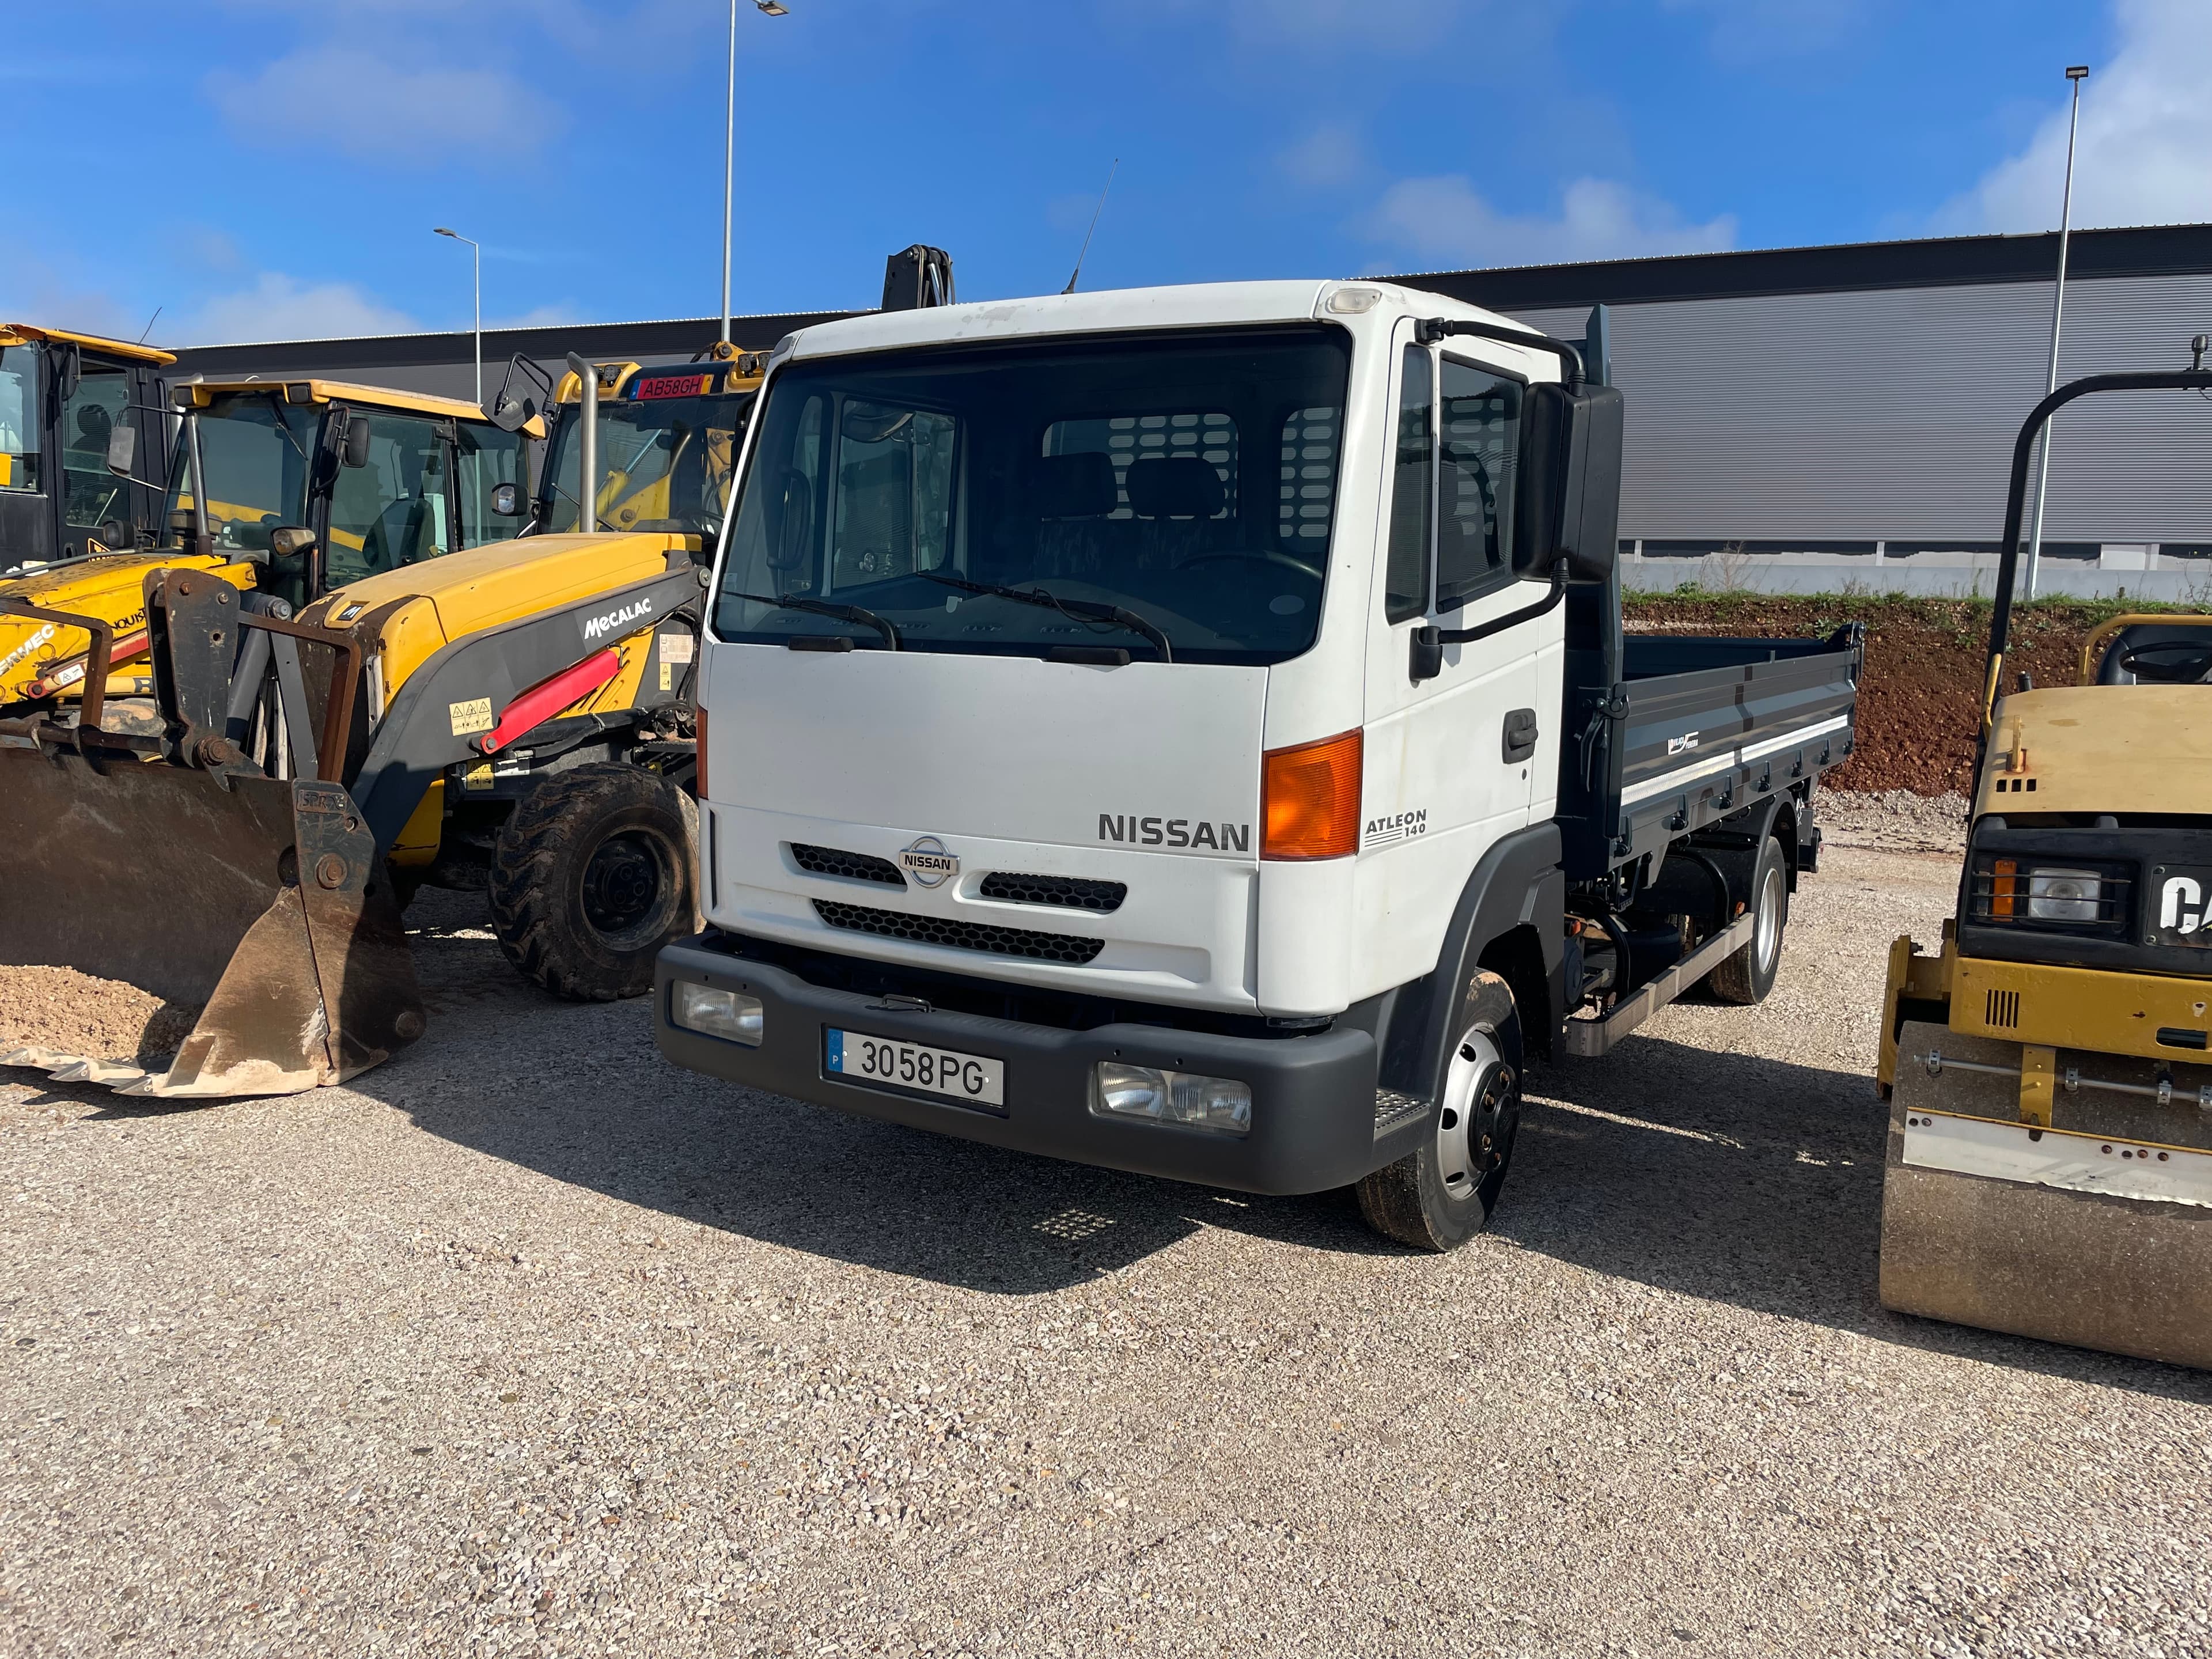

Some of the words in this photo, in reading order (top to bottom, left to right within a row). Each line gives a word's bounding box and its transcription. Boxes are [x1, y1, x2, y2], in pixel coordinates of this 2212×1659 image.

[643, 377, 701, 397] AB58GH
[1099, 813, 1249, 852] NISSAN
[1365, 809, 1426, 834] ATLEON
[1404, 823, 1426, 837] 140
[904, 854, 950, 870] NISSAN
[832, 1055, 839, 1065] P
[861, 1041, 983, 1094] 3058PG
